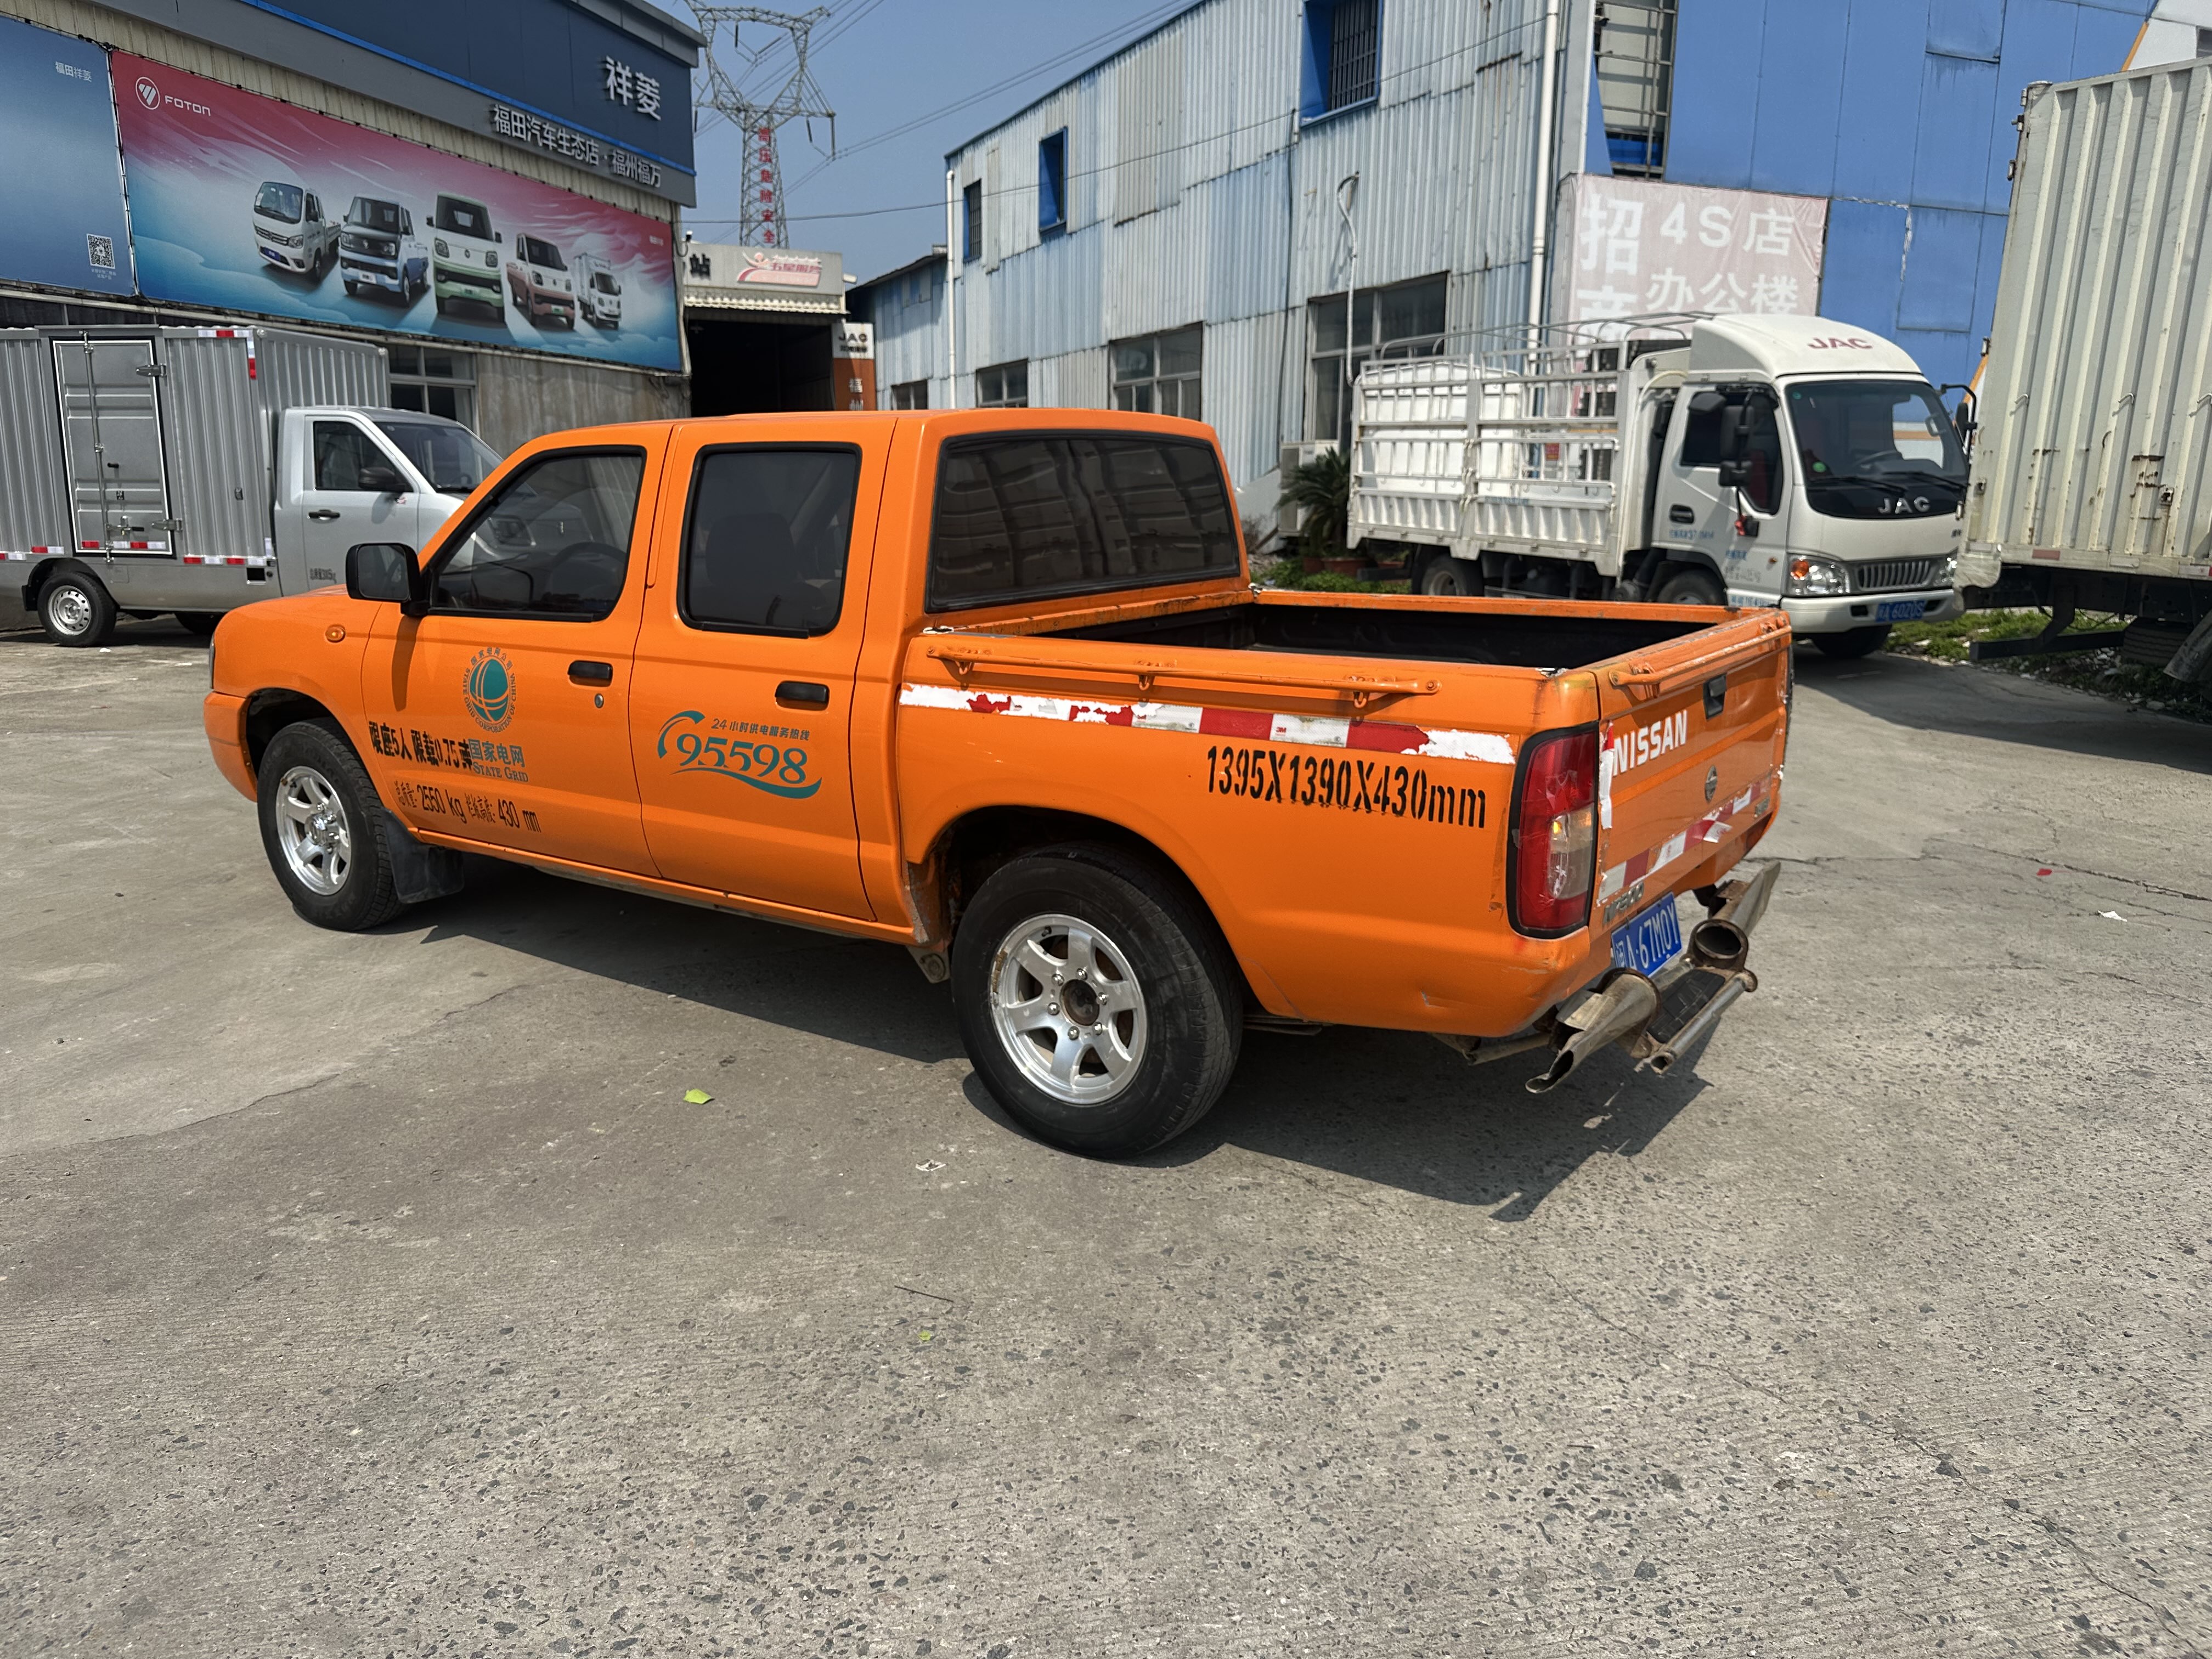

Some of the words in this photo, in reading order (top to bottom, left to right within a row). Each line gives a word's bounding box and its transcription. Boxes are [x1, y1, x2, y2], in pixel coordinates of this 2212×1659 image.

[165, 95, 211, 116] FOTON
[606, 55, 661, 120] 祥菱
[1660, 202, 1796, 256] 4S店
[690, 254, 711, 278] 站
[1646, 267, 1798, 315] 办公楼
[839, 332, 867, 343] JAC
[1807, 337, 1872, 349] JAC
[1877, 496, 1930, 515] JAC
[468, 738, 525, 768] 国家电网
[676, 733, 808, 784] 95598
[1613, 709, 1688, 777] NISSAN
[416, 784, 446, 814] 2550
[444, 788, 467, 824] kg
[498, 798, 520, 829] 430
[522, 809, 541, 833] mm
